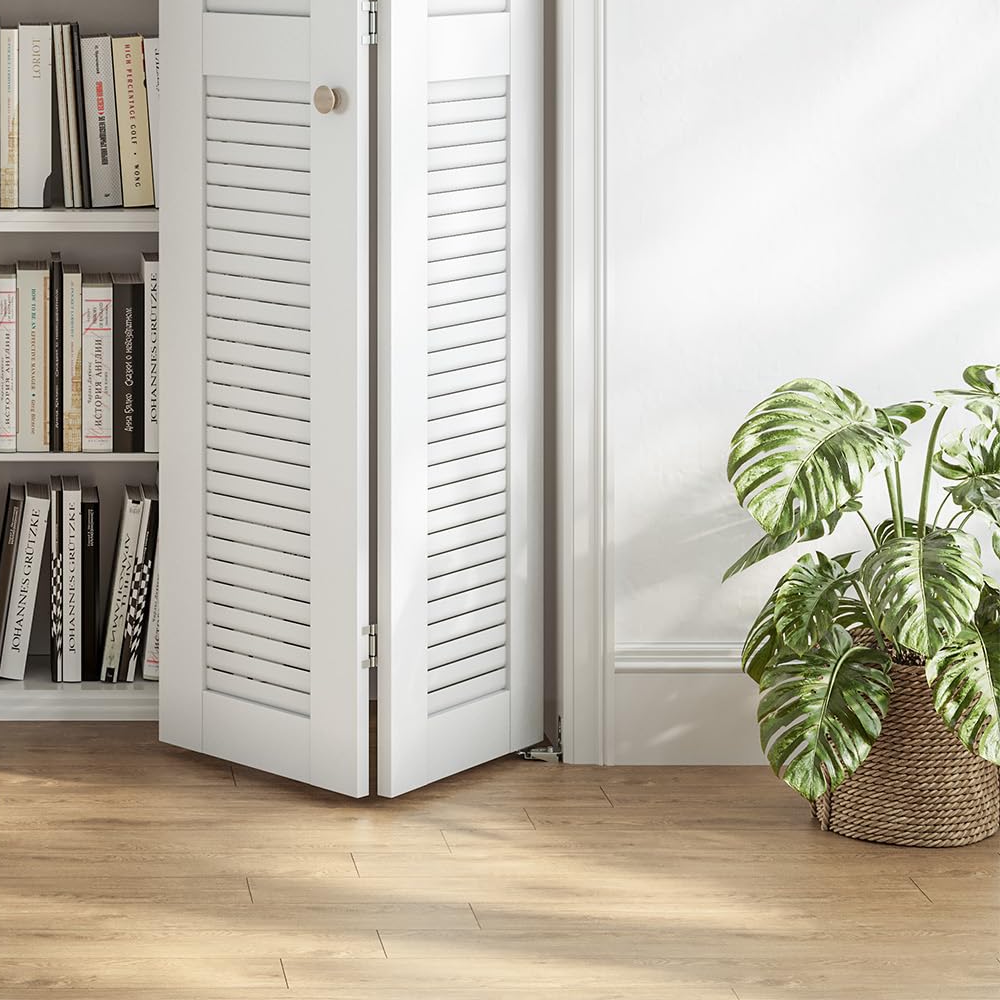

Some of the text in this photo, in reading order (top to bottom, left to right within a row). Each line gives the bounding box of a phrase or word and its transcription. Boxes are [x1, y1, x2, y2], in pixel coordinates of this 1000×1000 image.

[32, 38, 41, 79] LORIOT
[126, 69, 135, 120] PERCENTAGE
[95, 339, 103, 426] ИСТОРИЯ АНГЛИИ
[124, 361, 133, 386] Сказки
[124, 415, 133, 432] Анна
[10, 509, 41, 653] JOHANNES GRÜTZKE
[68, 575, 76, 654] JOHANNES
